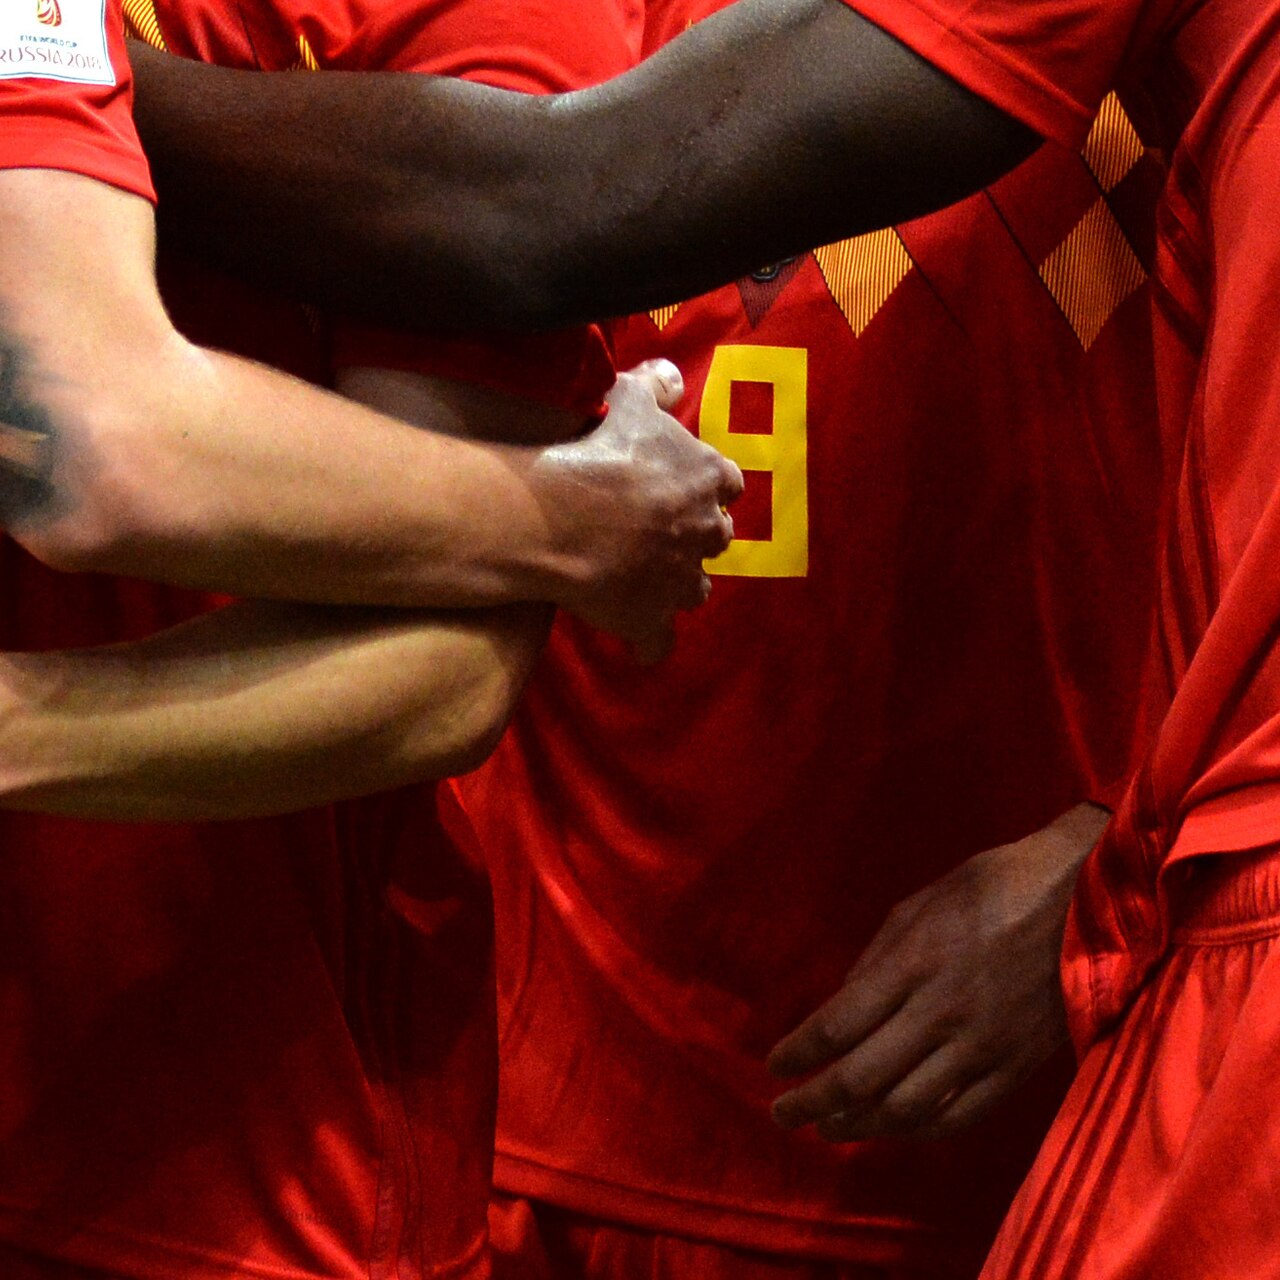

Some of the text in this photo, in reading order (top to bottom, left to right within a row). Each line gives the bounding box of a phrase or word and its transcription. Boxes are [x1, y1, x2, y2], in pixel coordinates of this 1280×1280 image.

[19, 34, 37, 43] FIFA
[39, 36, 65, 47] WORLD
[67, 51, 102, 70] 2018
